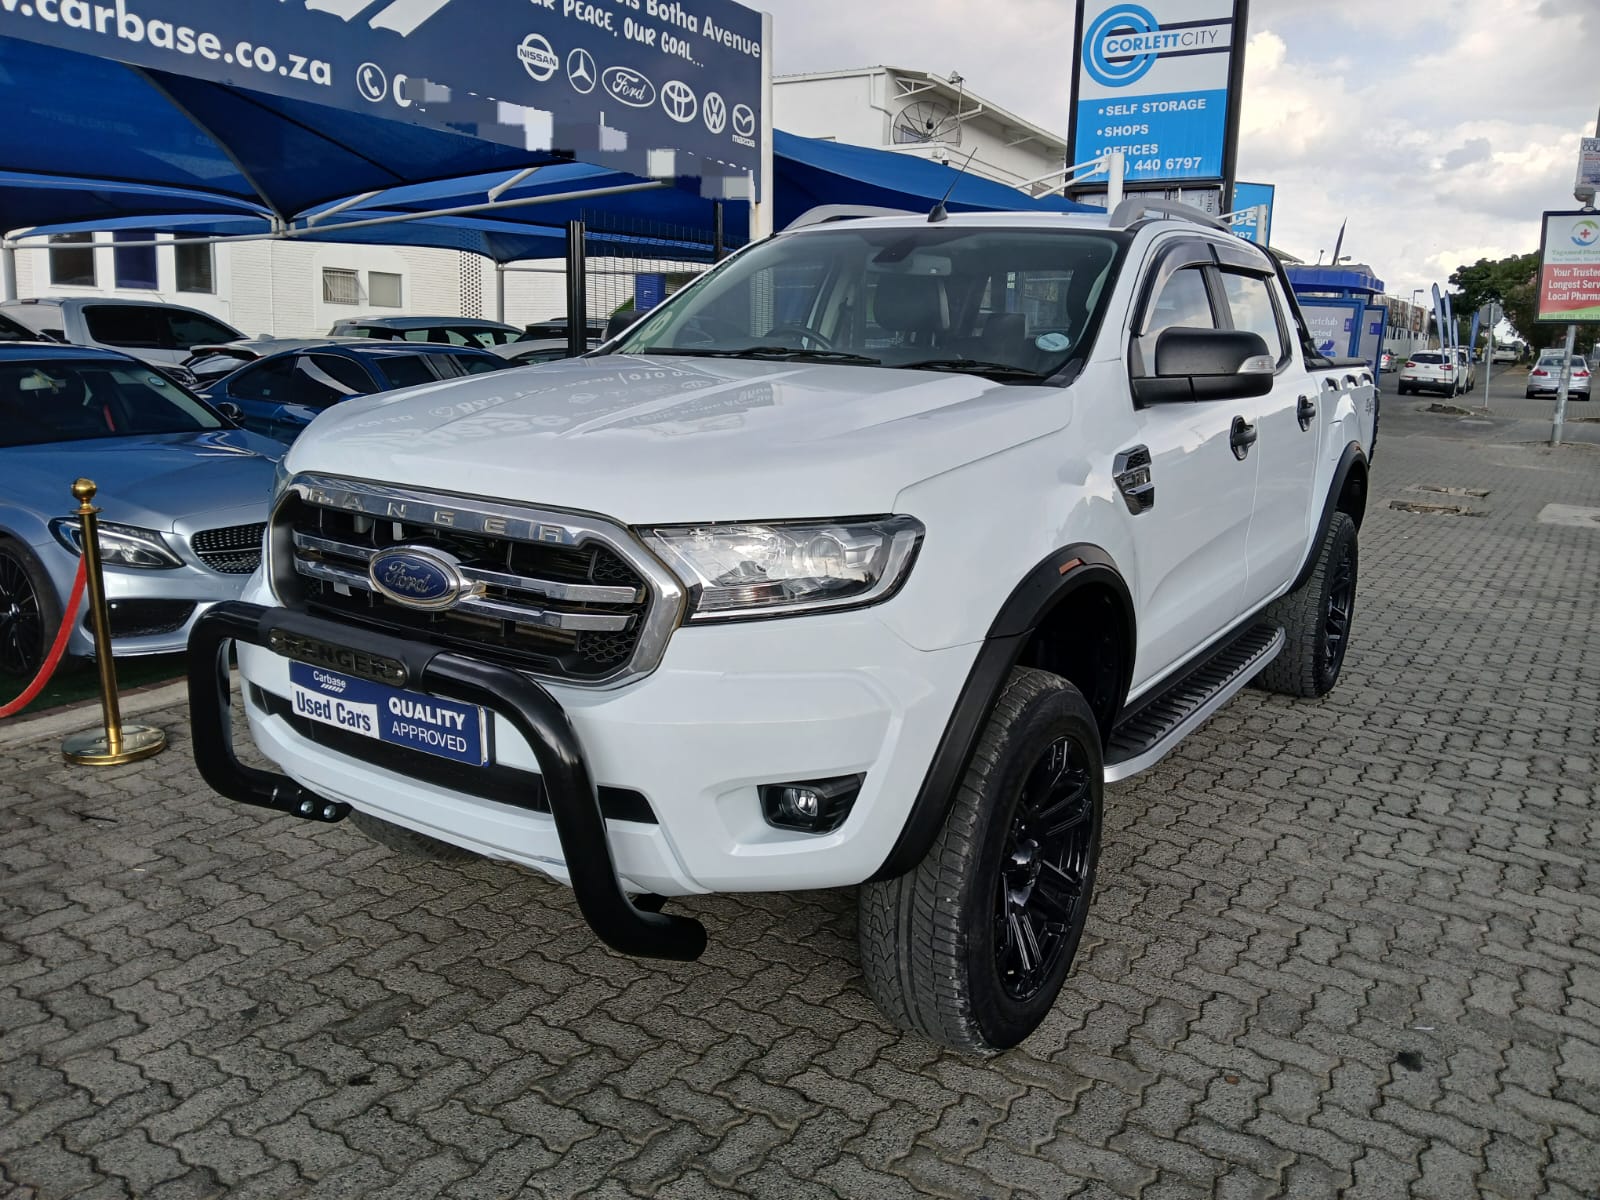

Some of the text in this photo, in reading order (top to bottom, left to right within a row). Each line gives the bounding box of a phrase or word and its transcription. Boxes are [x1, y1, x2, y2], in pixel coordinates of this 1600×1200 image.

[563, 0, 618, 37] PEACE,
[623, 17, 656, 48] OUR
[646, 0, 761, 58] Botha Avenue
[519, 48, 557, 67] NISSAN
[612, 71, 647, 101] Ford
[1105, 98, 1207, 116] SELF STORAGE
[1104, 124, 1150, 137] SHOPS
[1134, 159, 1161, 171] 440
[1165, 156, 1202, 170] 6797
[1553, 267, 1572, 277] Your
[1547, 291, 1570, 300] Local
[1548, 280, 1580, 290] Longest
[308, 487, 564, 543] RANGER
[385, 560, 437, 593] Ford
[313, 670, 346, 687] Carbase
[295, 690, 371, 732] Used Cars
[388, 696, 465, 730] QUALITY
[392, 721, 467, 752] APPROVED
